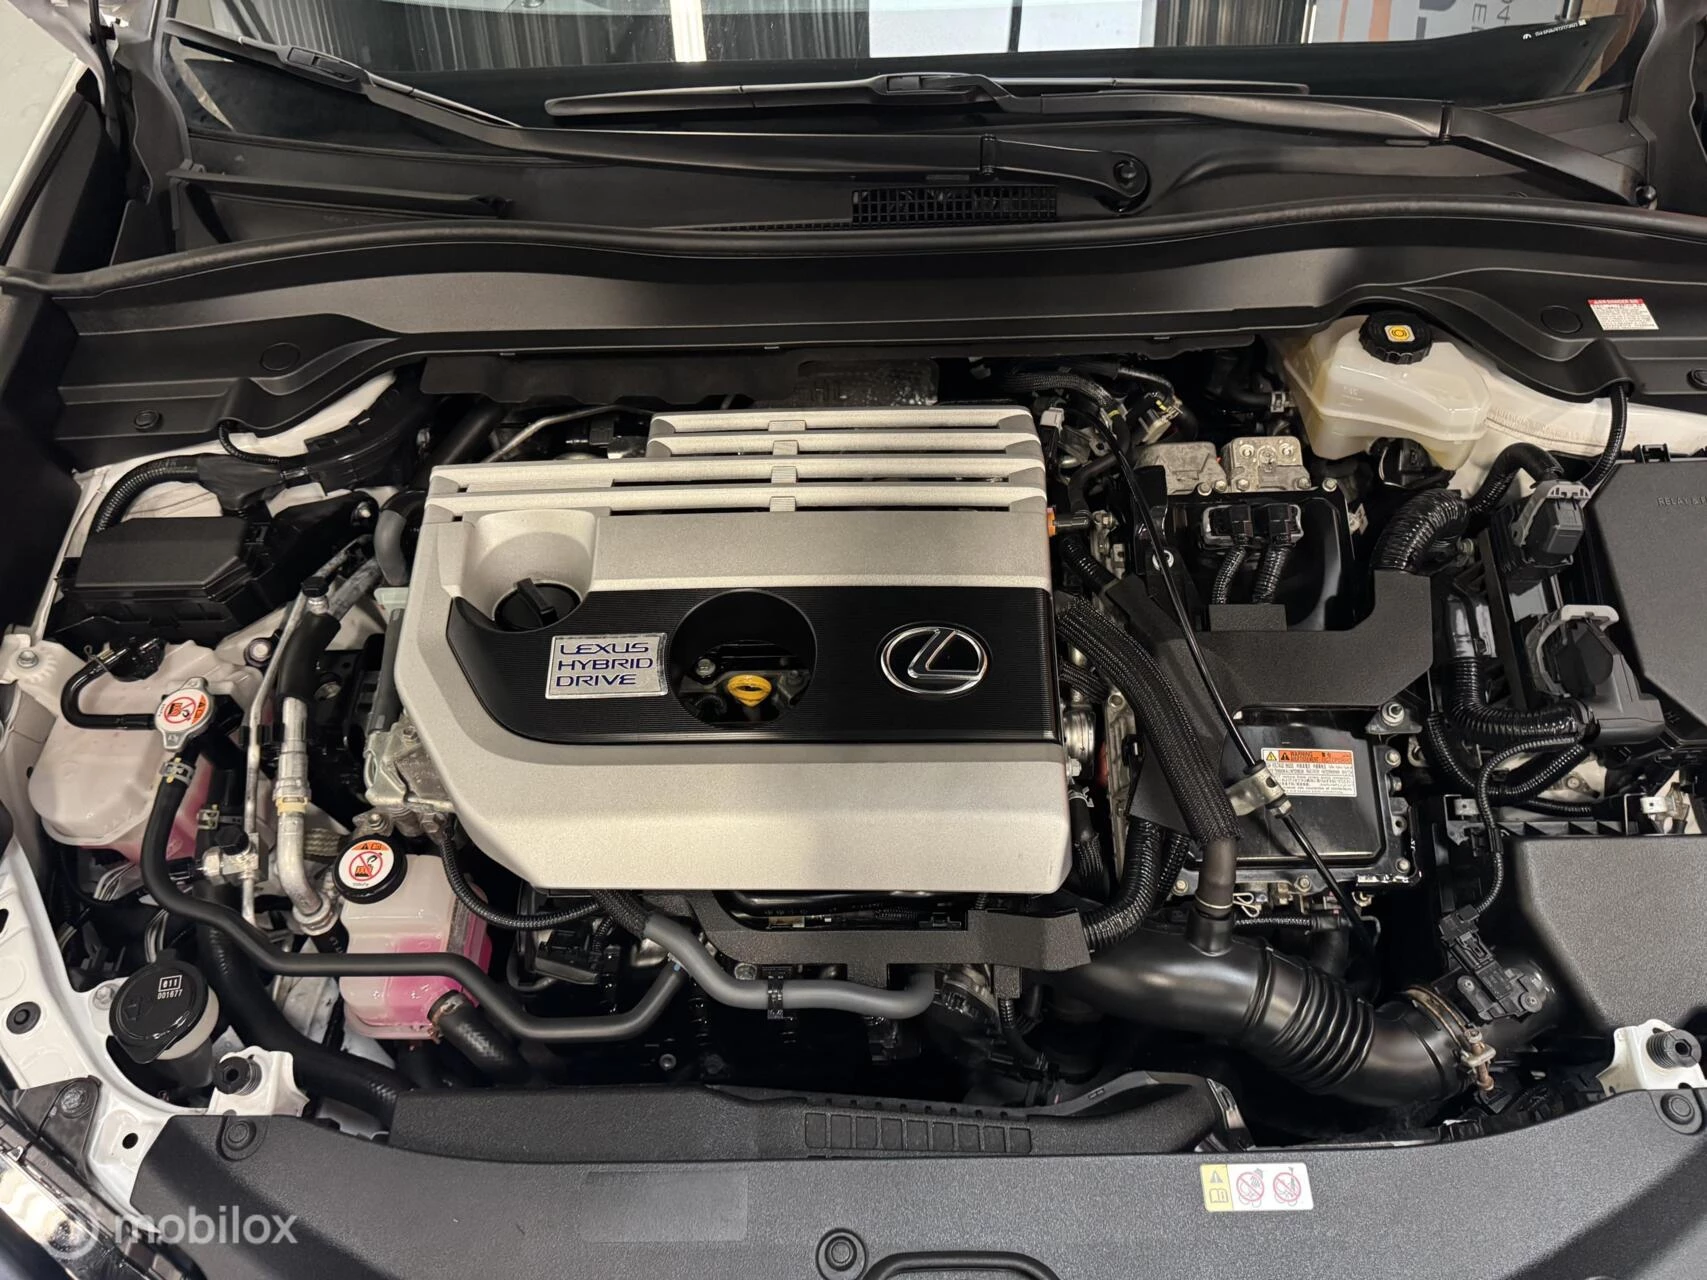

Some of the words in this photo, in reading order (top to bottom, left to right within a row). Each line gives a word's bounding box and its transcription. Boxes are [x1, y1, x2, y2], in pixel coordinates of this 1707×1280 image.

[560, 642, 649, 655] LEXUS
[557, 657, 653, 671] HYBRID
[556, 673, 637, 687] DRIVE
